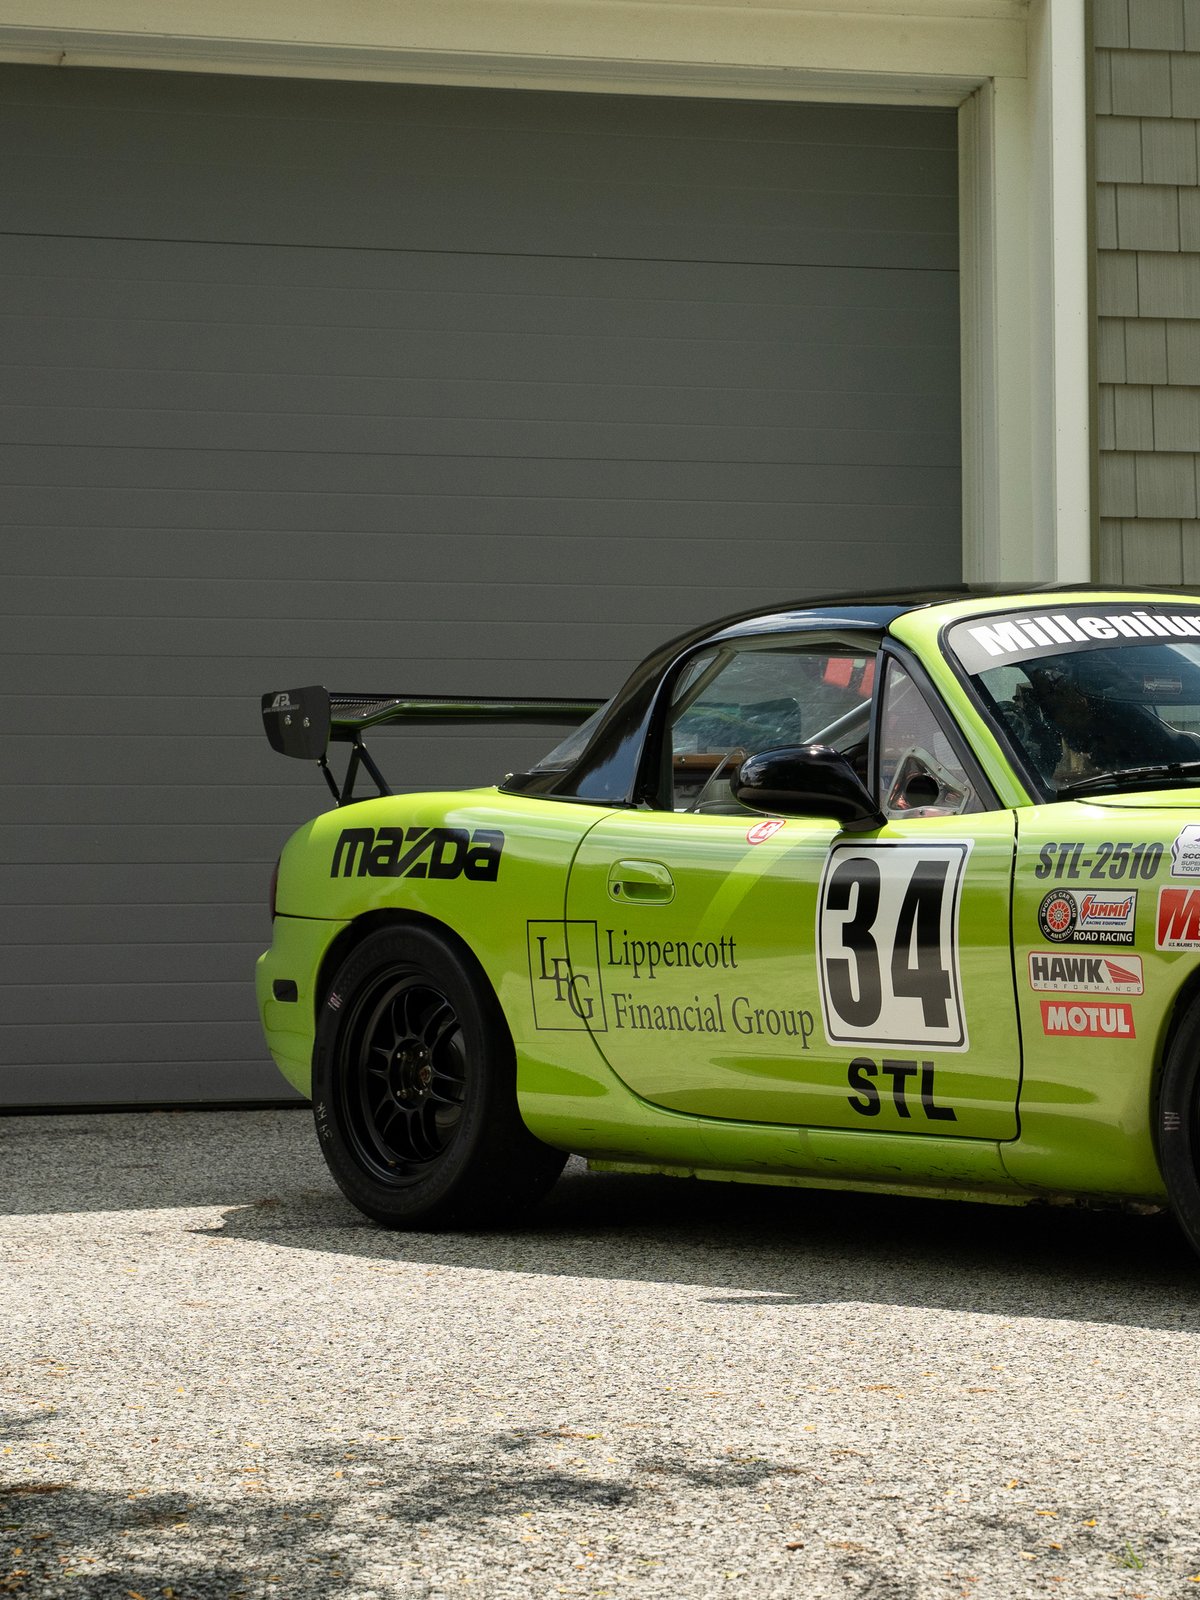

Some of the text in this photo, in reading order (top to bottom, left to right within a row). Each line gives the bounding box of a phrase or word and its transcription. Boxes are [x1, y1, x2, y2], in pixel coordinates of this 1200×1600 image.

[1035, 842, 1164, 880] STL-2510
[1041, 892, 1078, 918] SPORTS CAR CLUB
[826, 857, 953, 1028] 34
[1043, 924, 1075, 939] OF AMERICA
[1073, 931, 1133, 942] ROAD RACING
[605, 929, 738, 979] Lippencott
[1031, 957, 1104, 983] HAWK
[1033, 983, 1142, 993] PERFORMANCE
[611, 993, 815, 1049] Financial Group
[1047, 1006, 1130, 1033] MOTUL
[847, 1056, 958, 1122] STL
